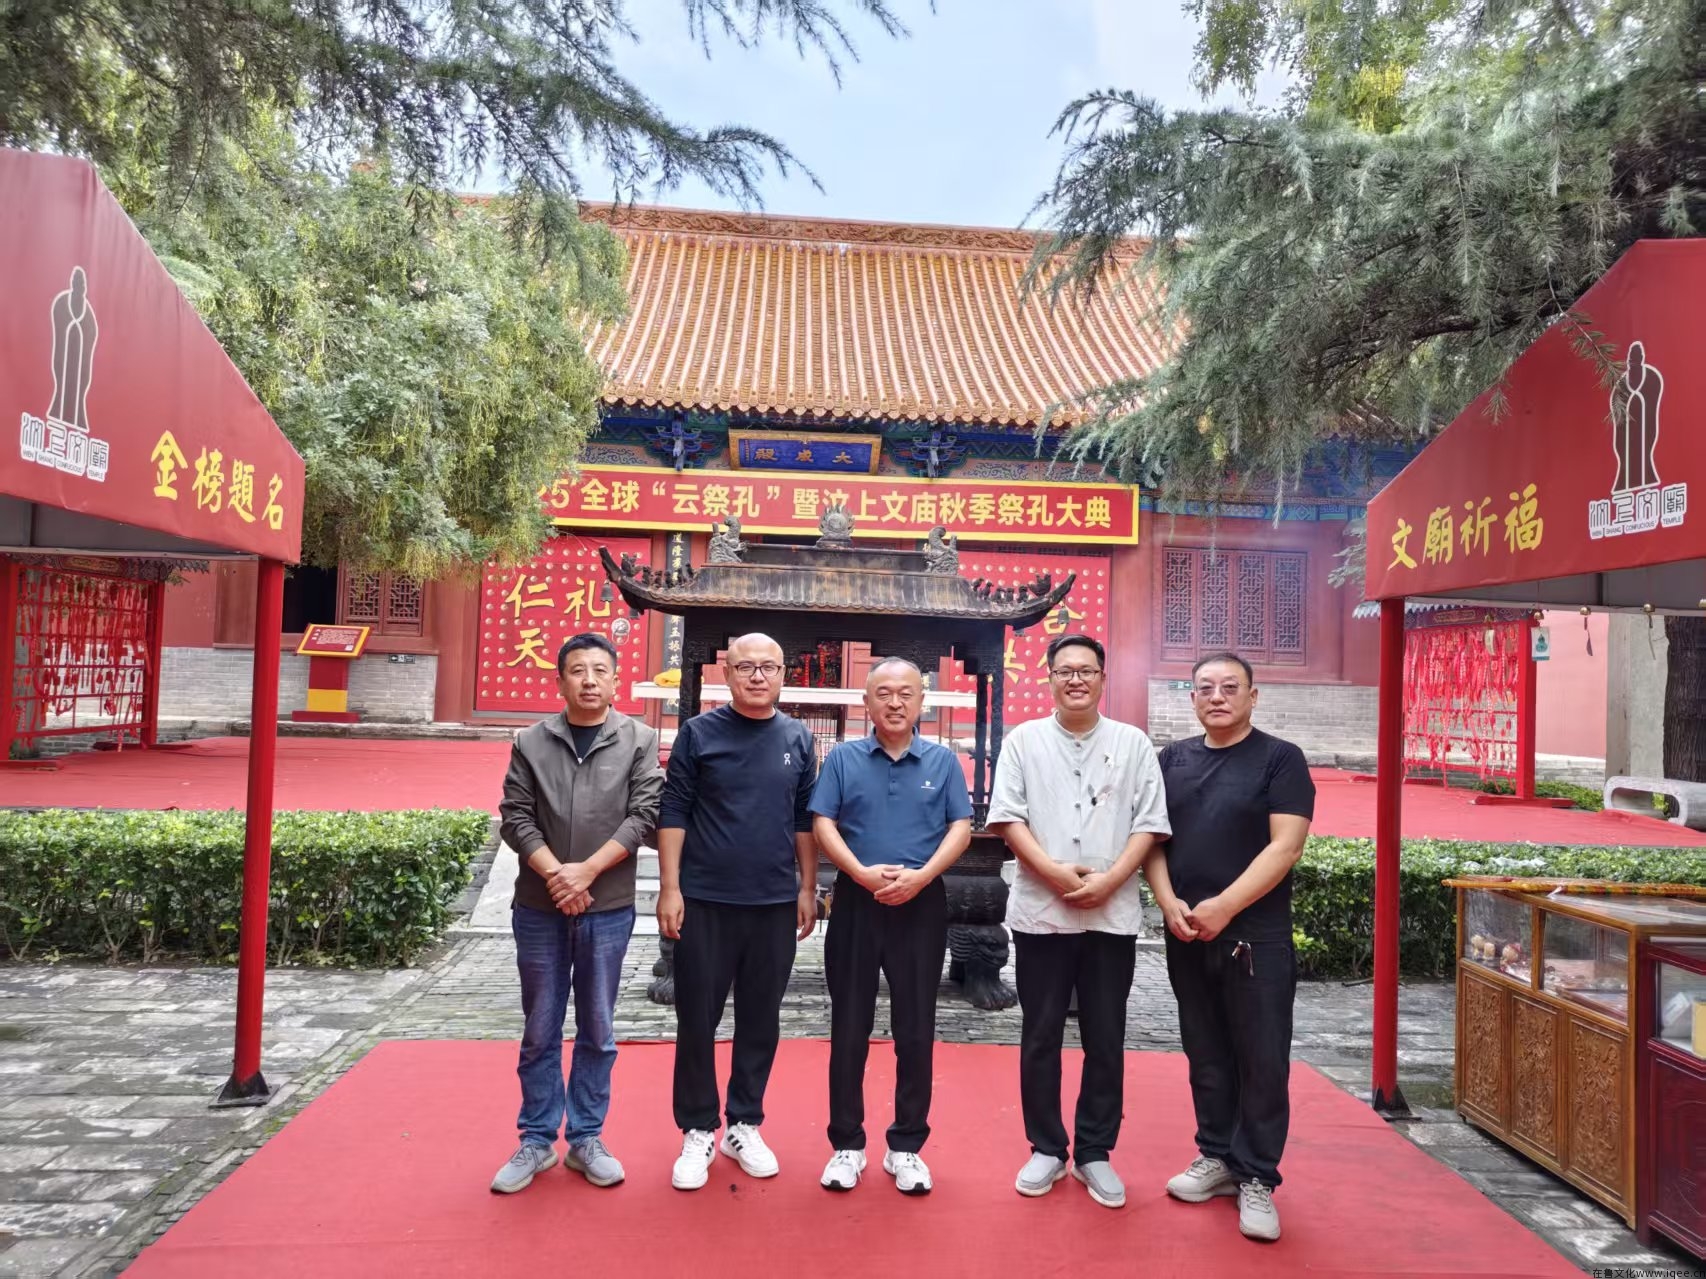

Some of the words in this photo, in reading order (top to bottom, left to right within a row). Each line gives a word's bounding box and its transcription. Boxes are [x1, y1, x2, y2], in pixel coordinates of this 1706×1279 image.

[151, 430, 284, 530] 金榜題名
[1387, 483, 1544, 570] 文廟祈福
[1662, 515, 1681, 525] TEMPLE
[505, 574, 611, 620] 仁礼
